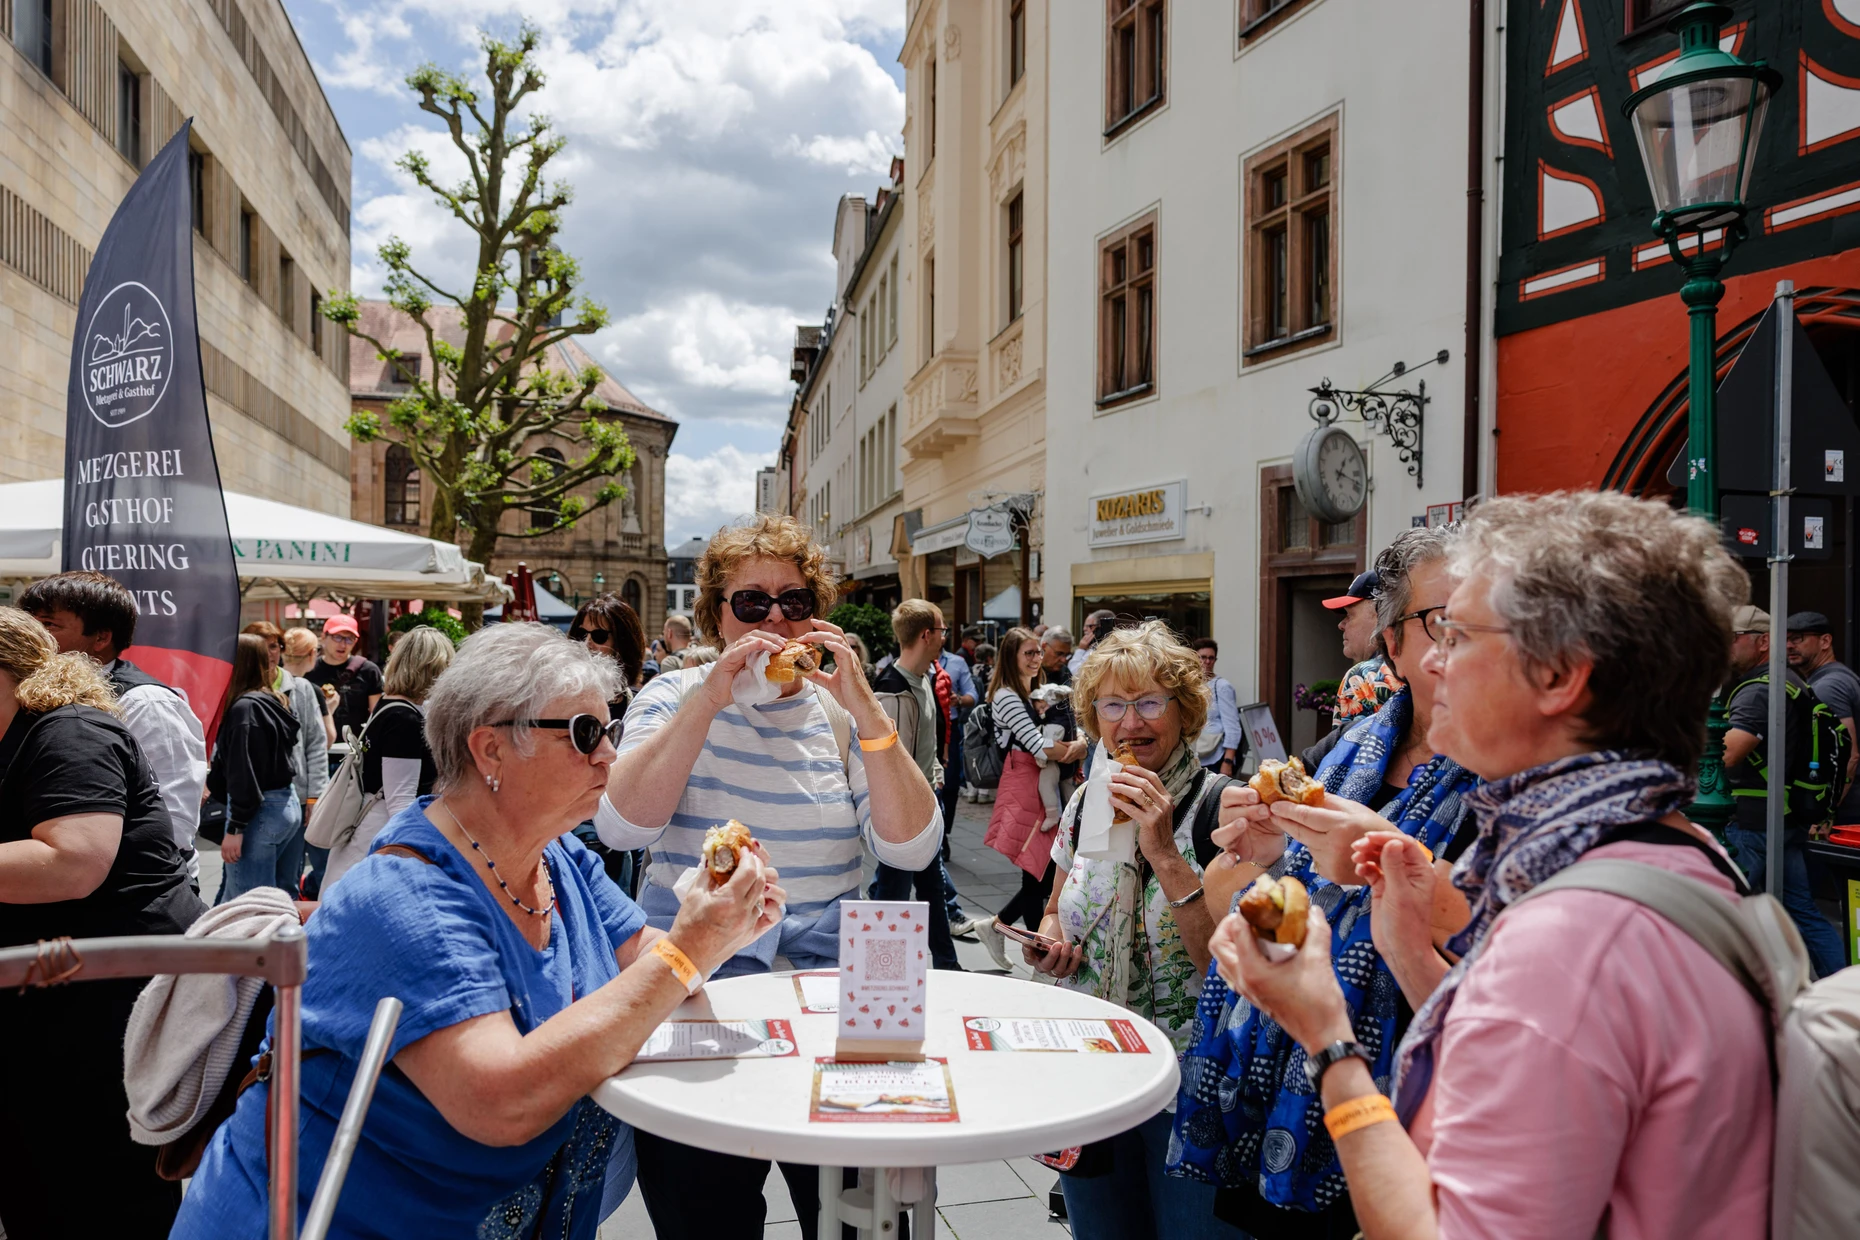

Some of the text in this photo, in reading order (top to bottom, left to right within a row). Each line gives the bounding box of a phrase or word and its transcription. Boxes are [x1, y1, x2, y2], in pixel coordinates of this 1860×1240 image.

[90, 355, 162, 393] SCHWARZ
[124, 384, 156, 398] Gasthof
[78, 449, 184, 485] MEZGEREI
[1096, 489, 1166, 522] KOZARIS
[1126, 518, 1174, 535] Goldschmiede
[256, 539, 352, 563] PANINI
[1261, 726, 1276, 744] %
